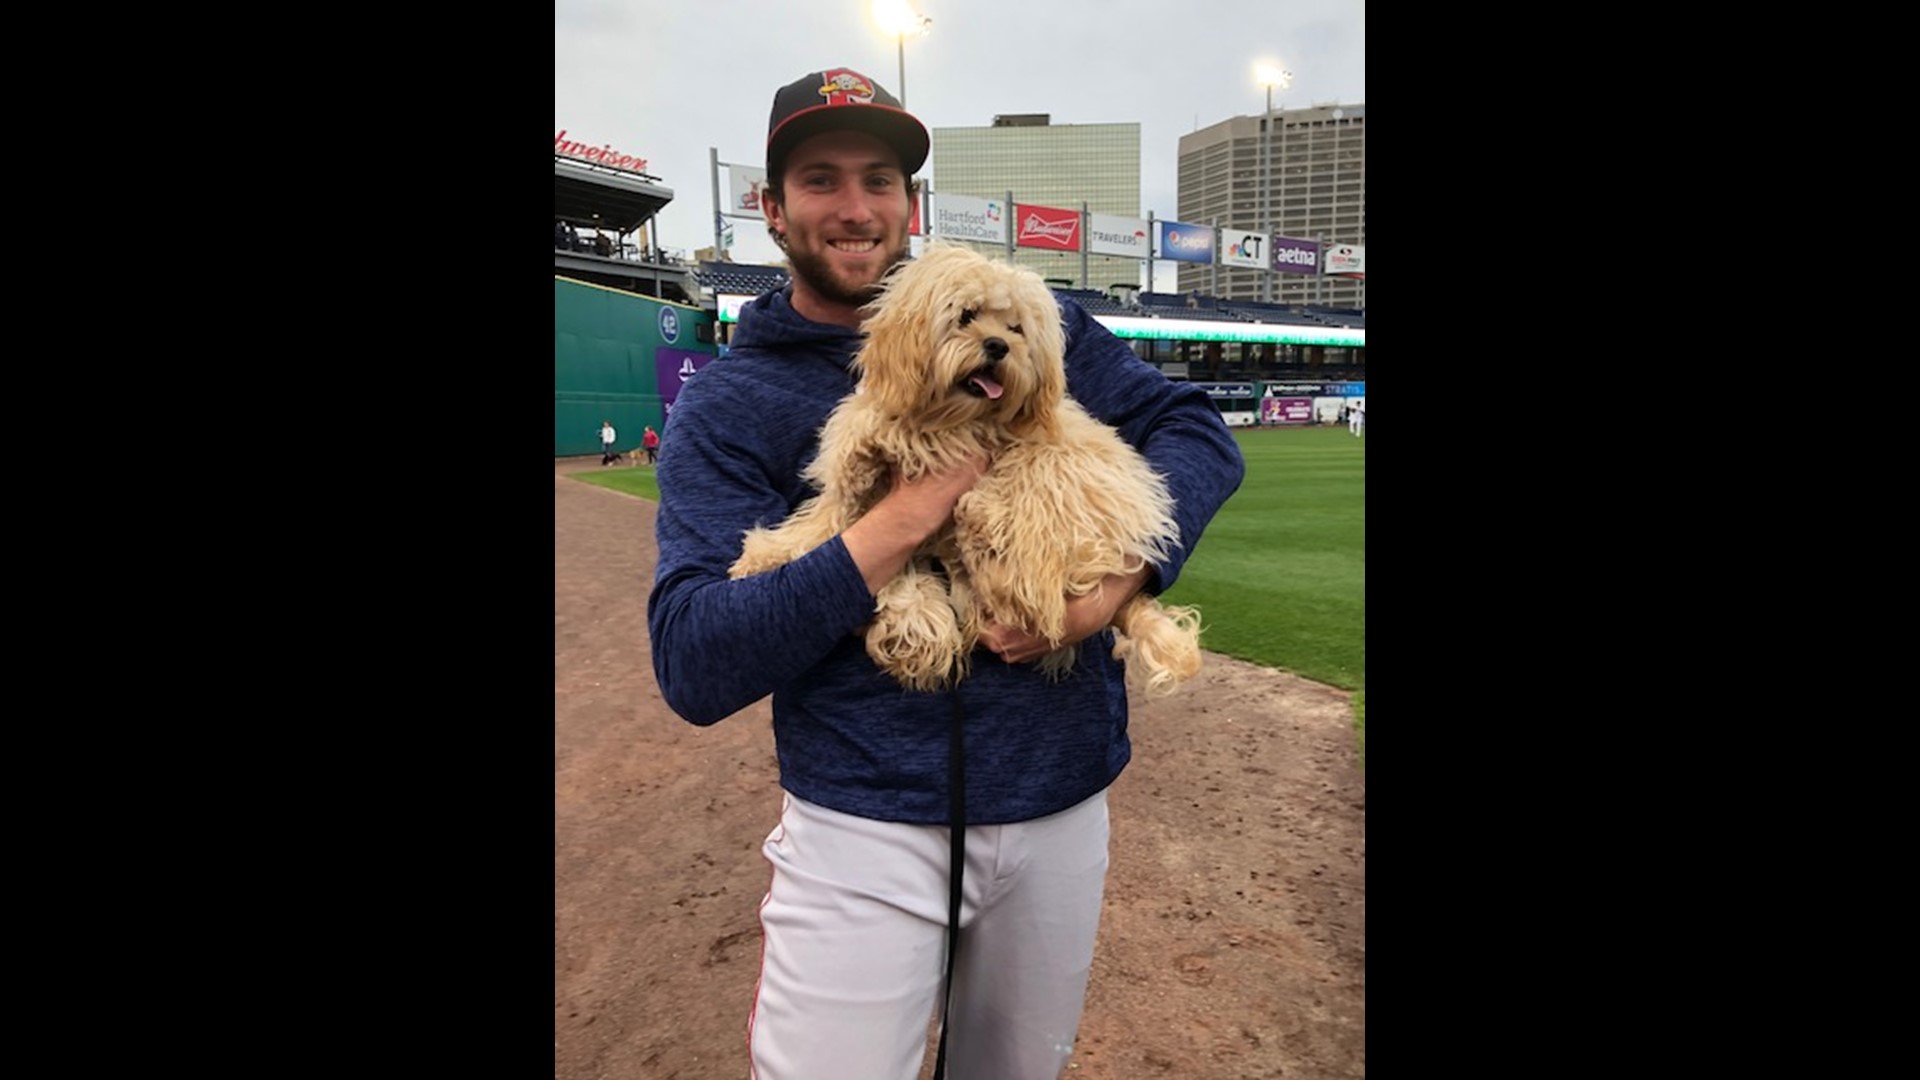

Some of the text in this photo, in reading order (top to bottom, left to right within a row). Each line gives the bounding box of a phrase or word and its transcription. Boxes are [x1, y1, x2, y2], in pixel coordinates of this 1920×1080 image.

[939, 209, 986, 225] Hartford
[939, 222, 998, 239] HealthCare
[1025, 219, 1073, 236] Budweiser
[1093, 231, 1137, 245] TRAVELERS
[1181, 236, 1209, 250] pepsi
[1242, 235, 1262, 259] CT
[1277, 247, 1316, 266] aetna
[663, 315, 676, 334] 42
